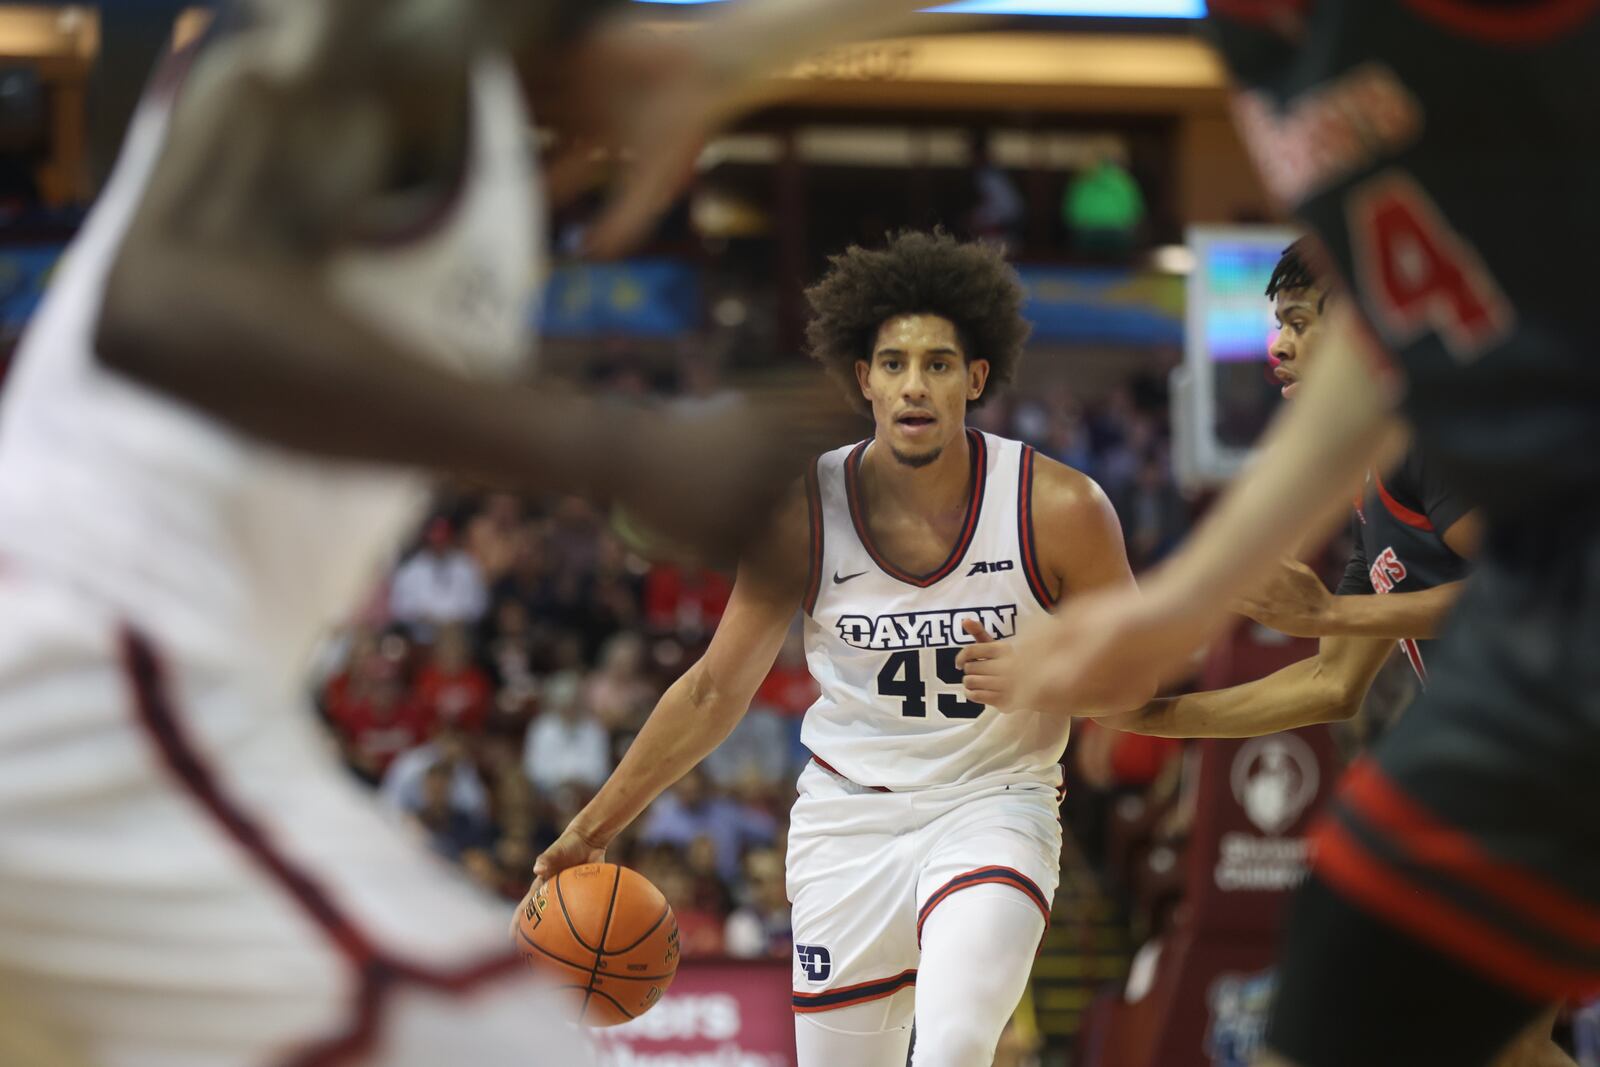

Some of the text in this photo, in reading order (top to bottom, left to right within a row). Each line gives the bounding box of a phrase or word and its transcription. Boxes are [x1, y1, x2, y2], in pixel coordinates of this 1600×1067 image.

[1342, 168, 1515, 364] 4
[966, 559, 1014, 577] A10
[836, 604, 1017, 651] DAYTON
[877, 648, 986, 719] 45
